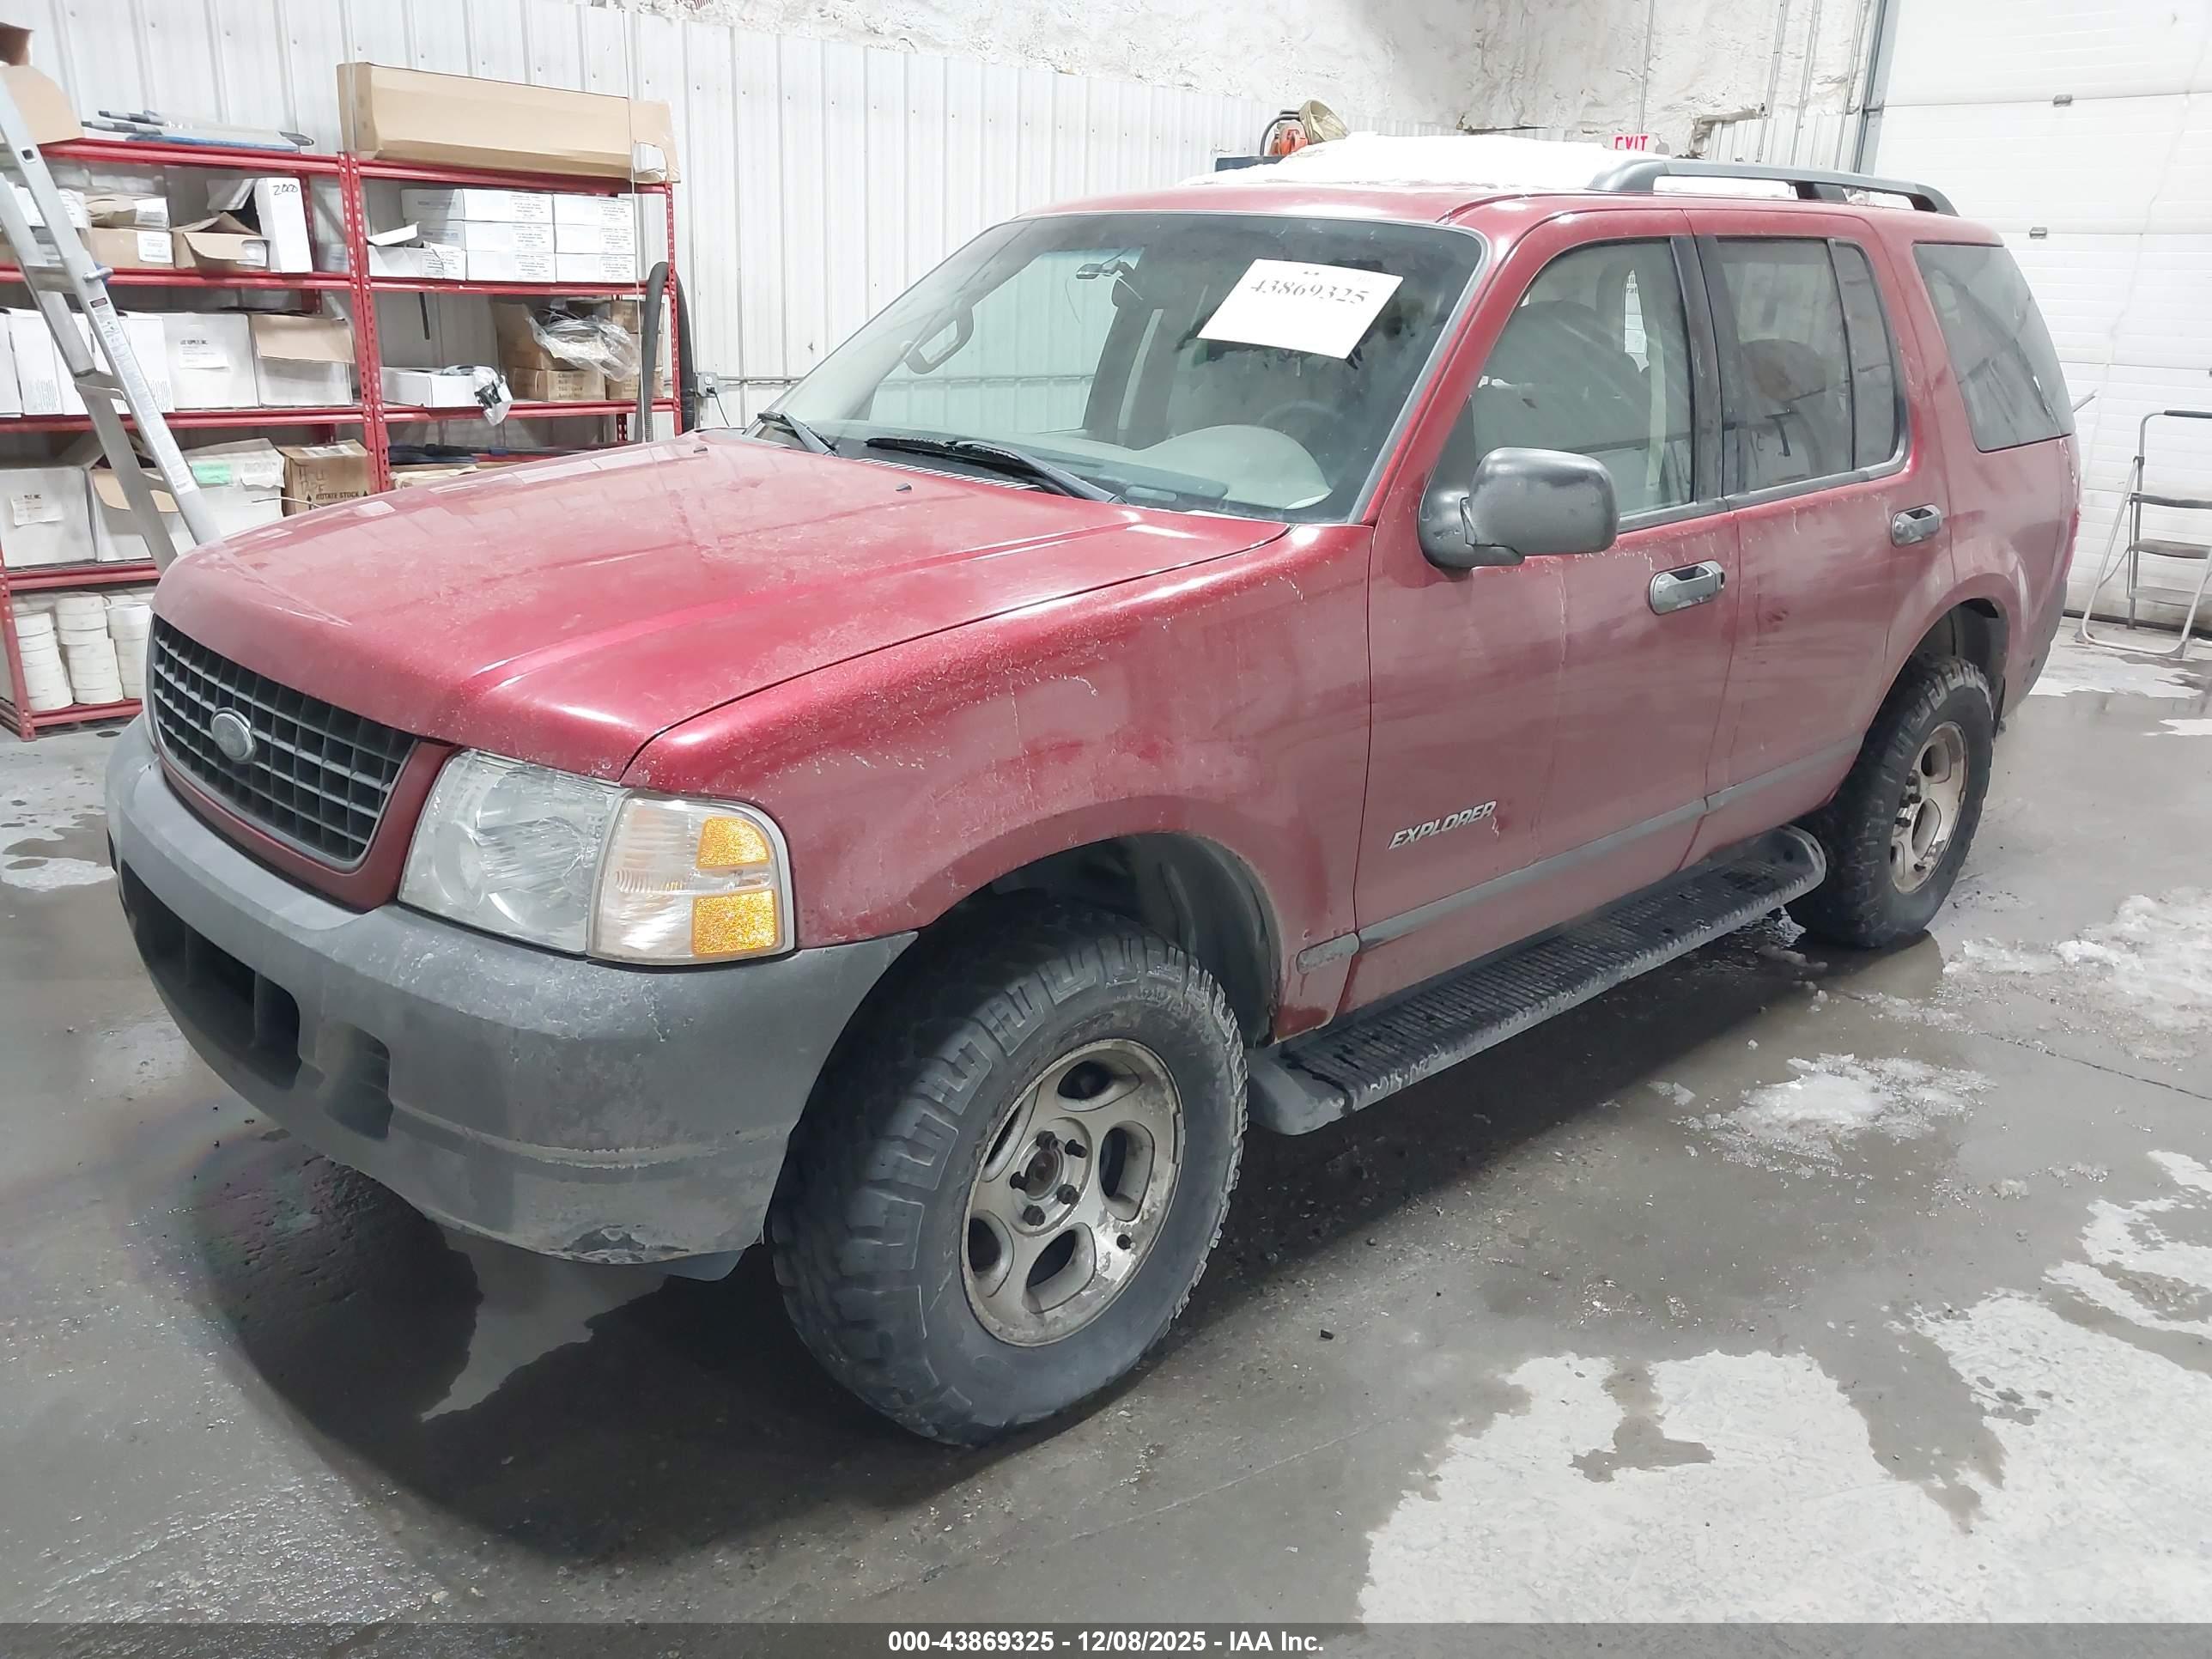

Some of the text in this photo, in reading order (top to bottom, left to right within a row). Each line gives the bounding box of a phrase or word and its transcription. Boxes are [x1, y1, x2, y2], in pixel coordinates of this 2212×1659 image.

[1250, 278, 1370, 305] 43869325
[339, 490, 359, 499] STOCK
[1388, 799, 1497, 850] EXPLORER
